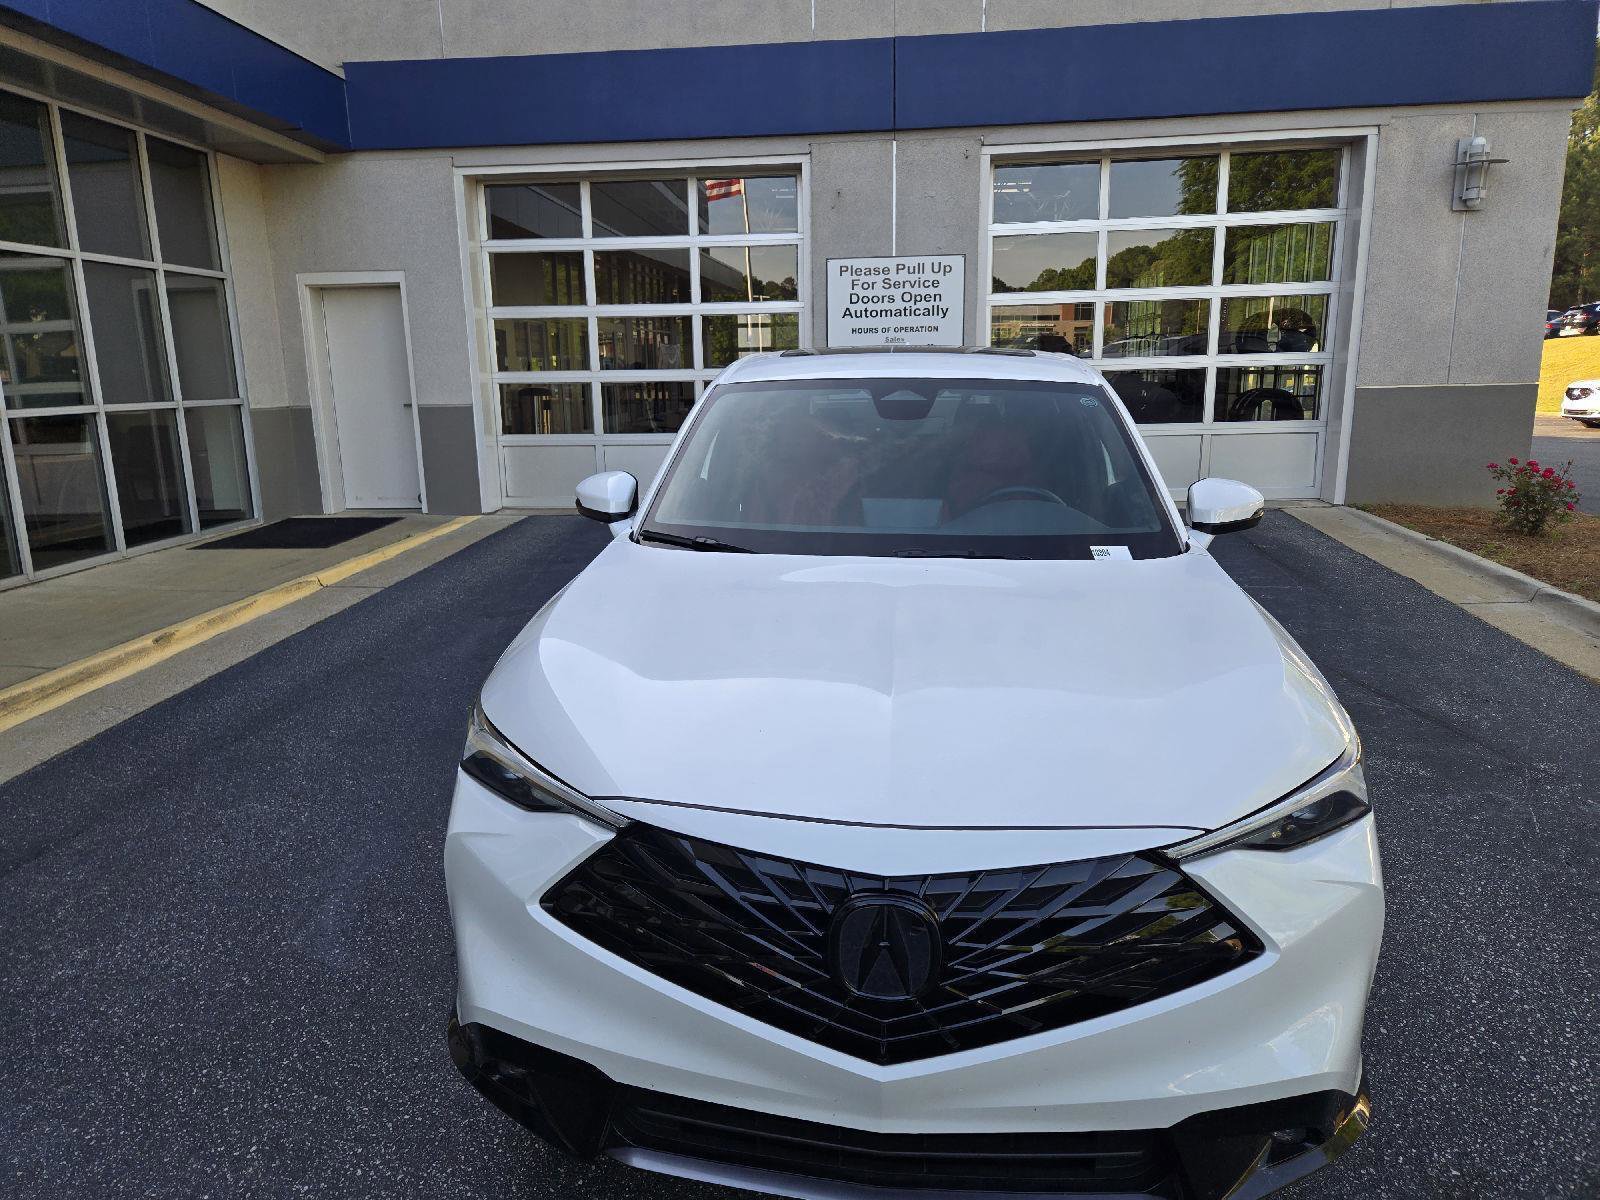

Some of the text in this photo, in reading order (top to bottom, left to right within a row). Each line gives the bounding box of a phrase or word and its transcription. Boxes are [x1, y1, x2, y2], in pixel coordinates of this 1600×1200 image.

[839, 261, 953, 277] Please Pull Up
[851, 277, 940, 290] For Service
[849, 291, 942, 305] Doors Open
[841, 304, 949, 319] Automatically
[851, 325, 939, 335] HOURS OF OPERATION
